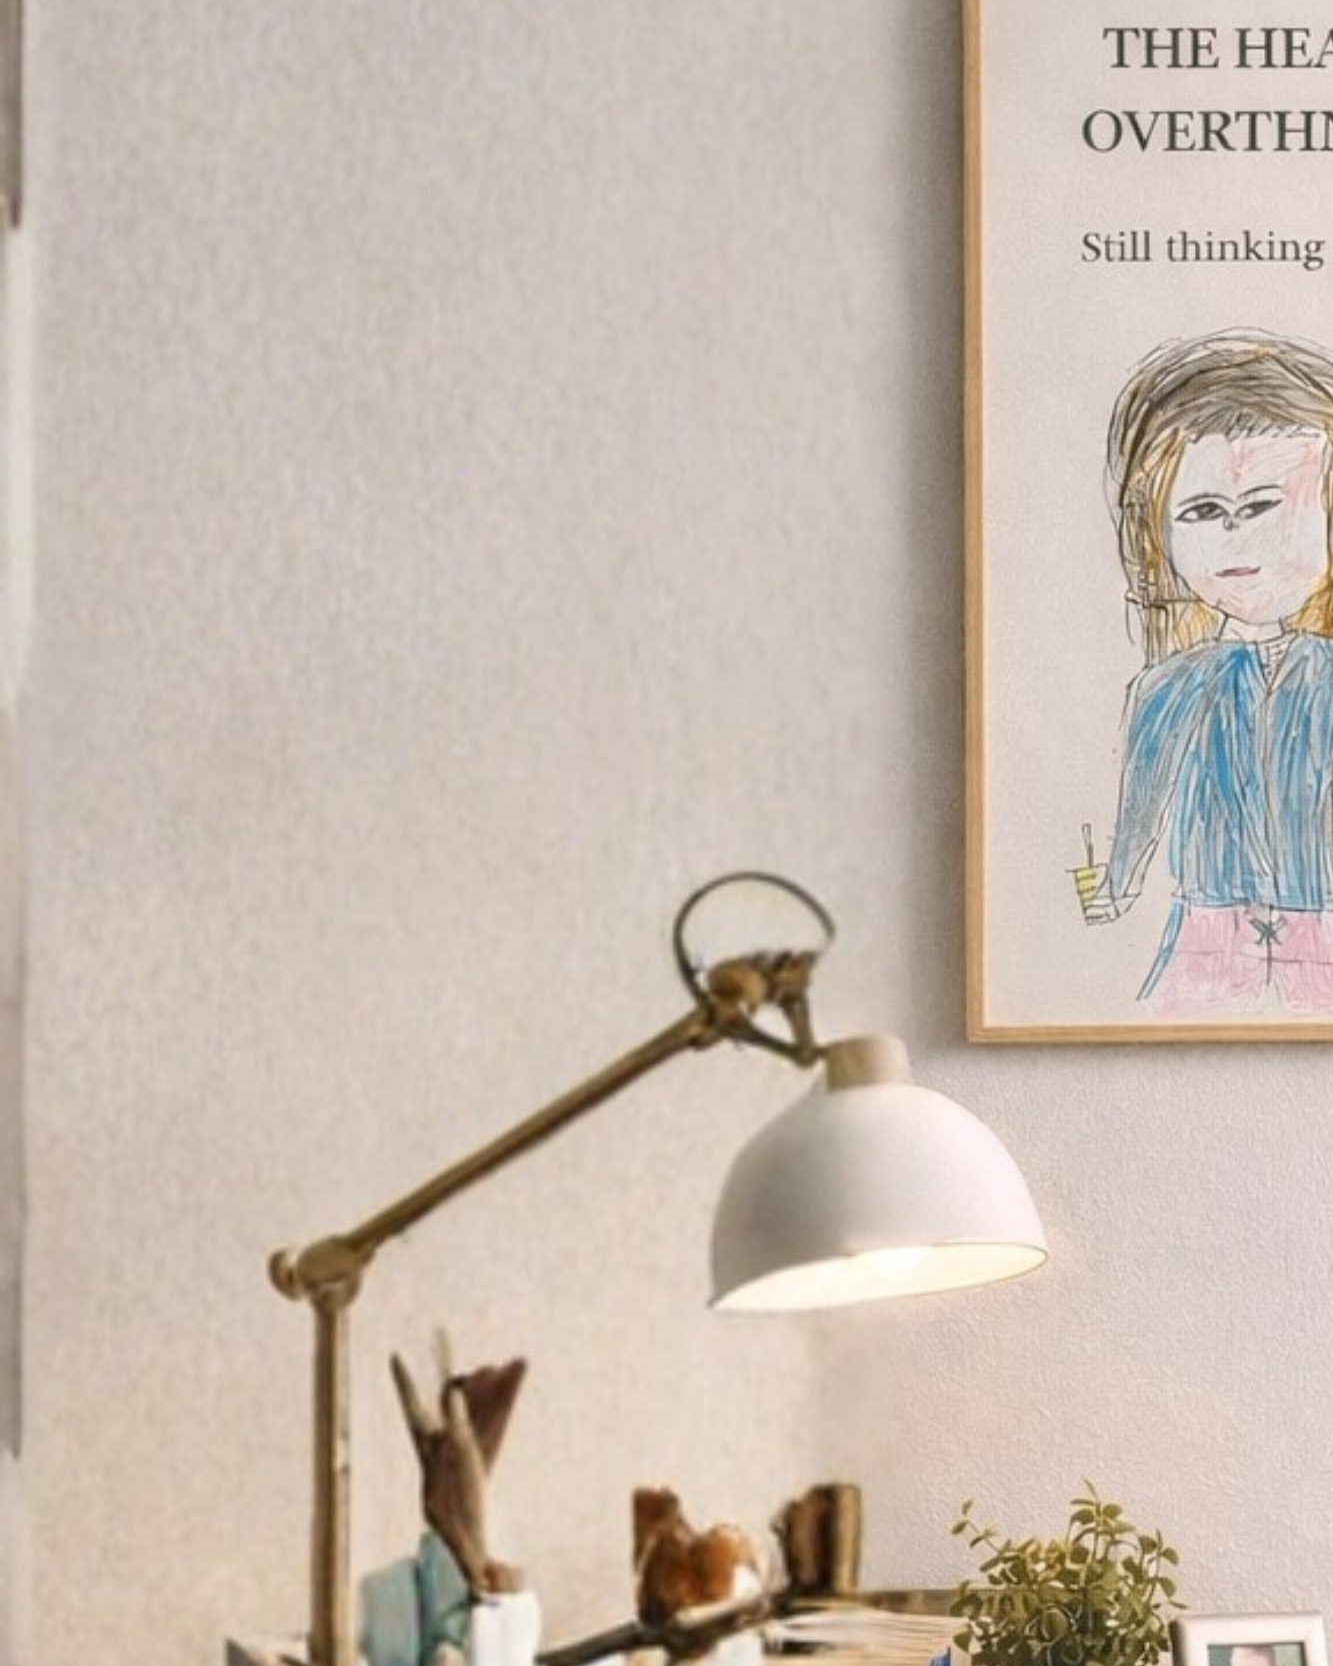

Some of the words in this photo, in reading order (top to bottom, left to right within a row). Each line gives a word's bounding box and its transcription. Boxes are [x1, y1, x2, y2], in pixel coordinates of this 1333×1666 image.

[1103, 27, 1220, 70] THE
[1081, 229, 1153, 264] Still
[1167, 229, 1327, 273] thinking
